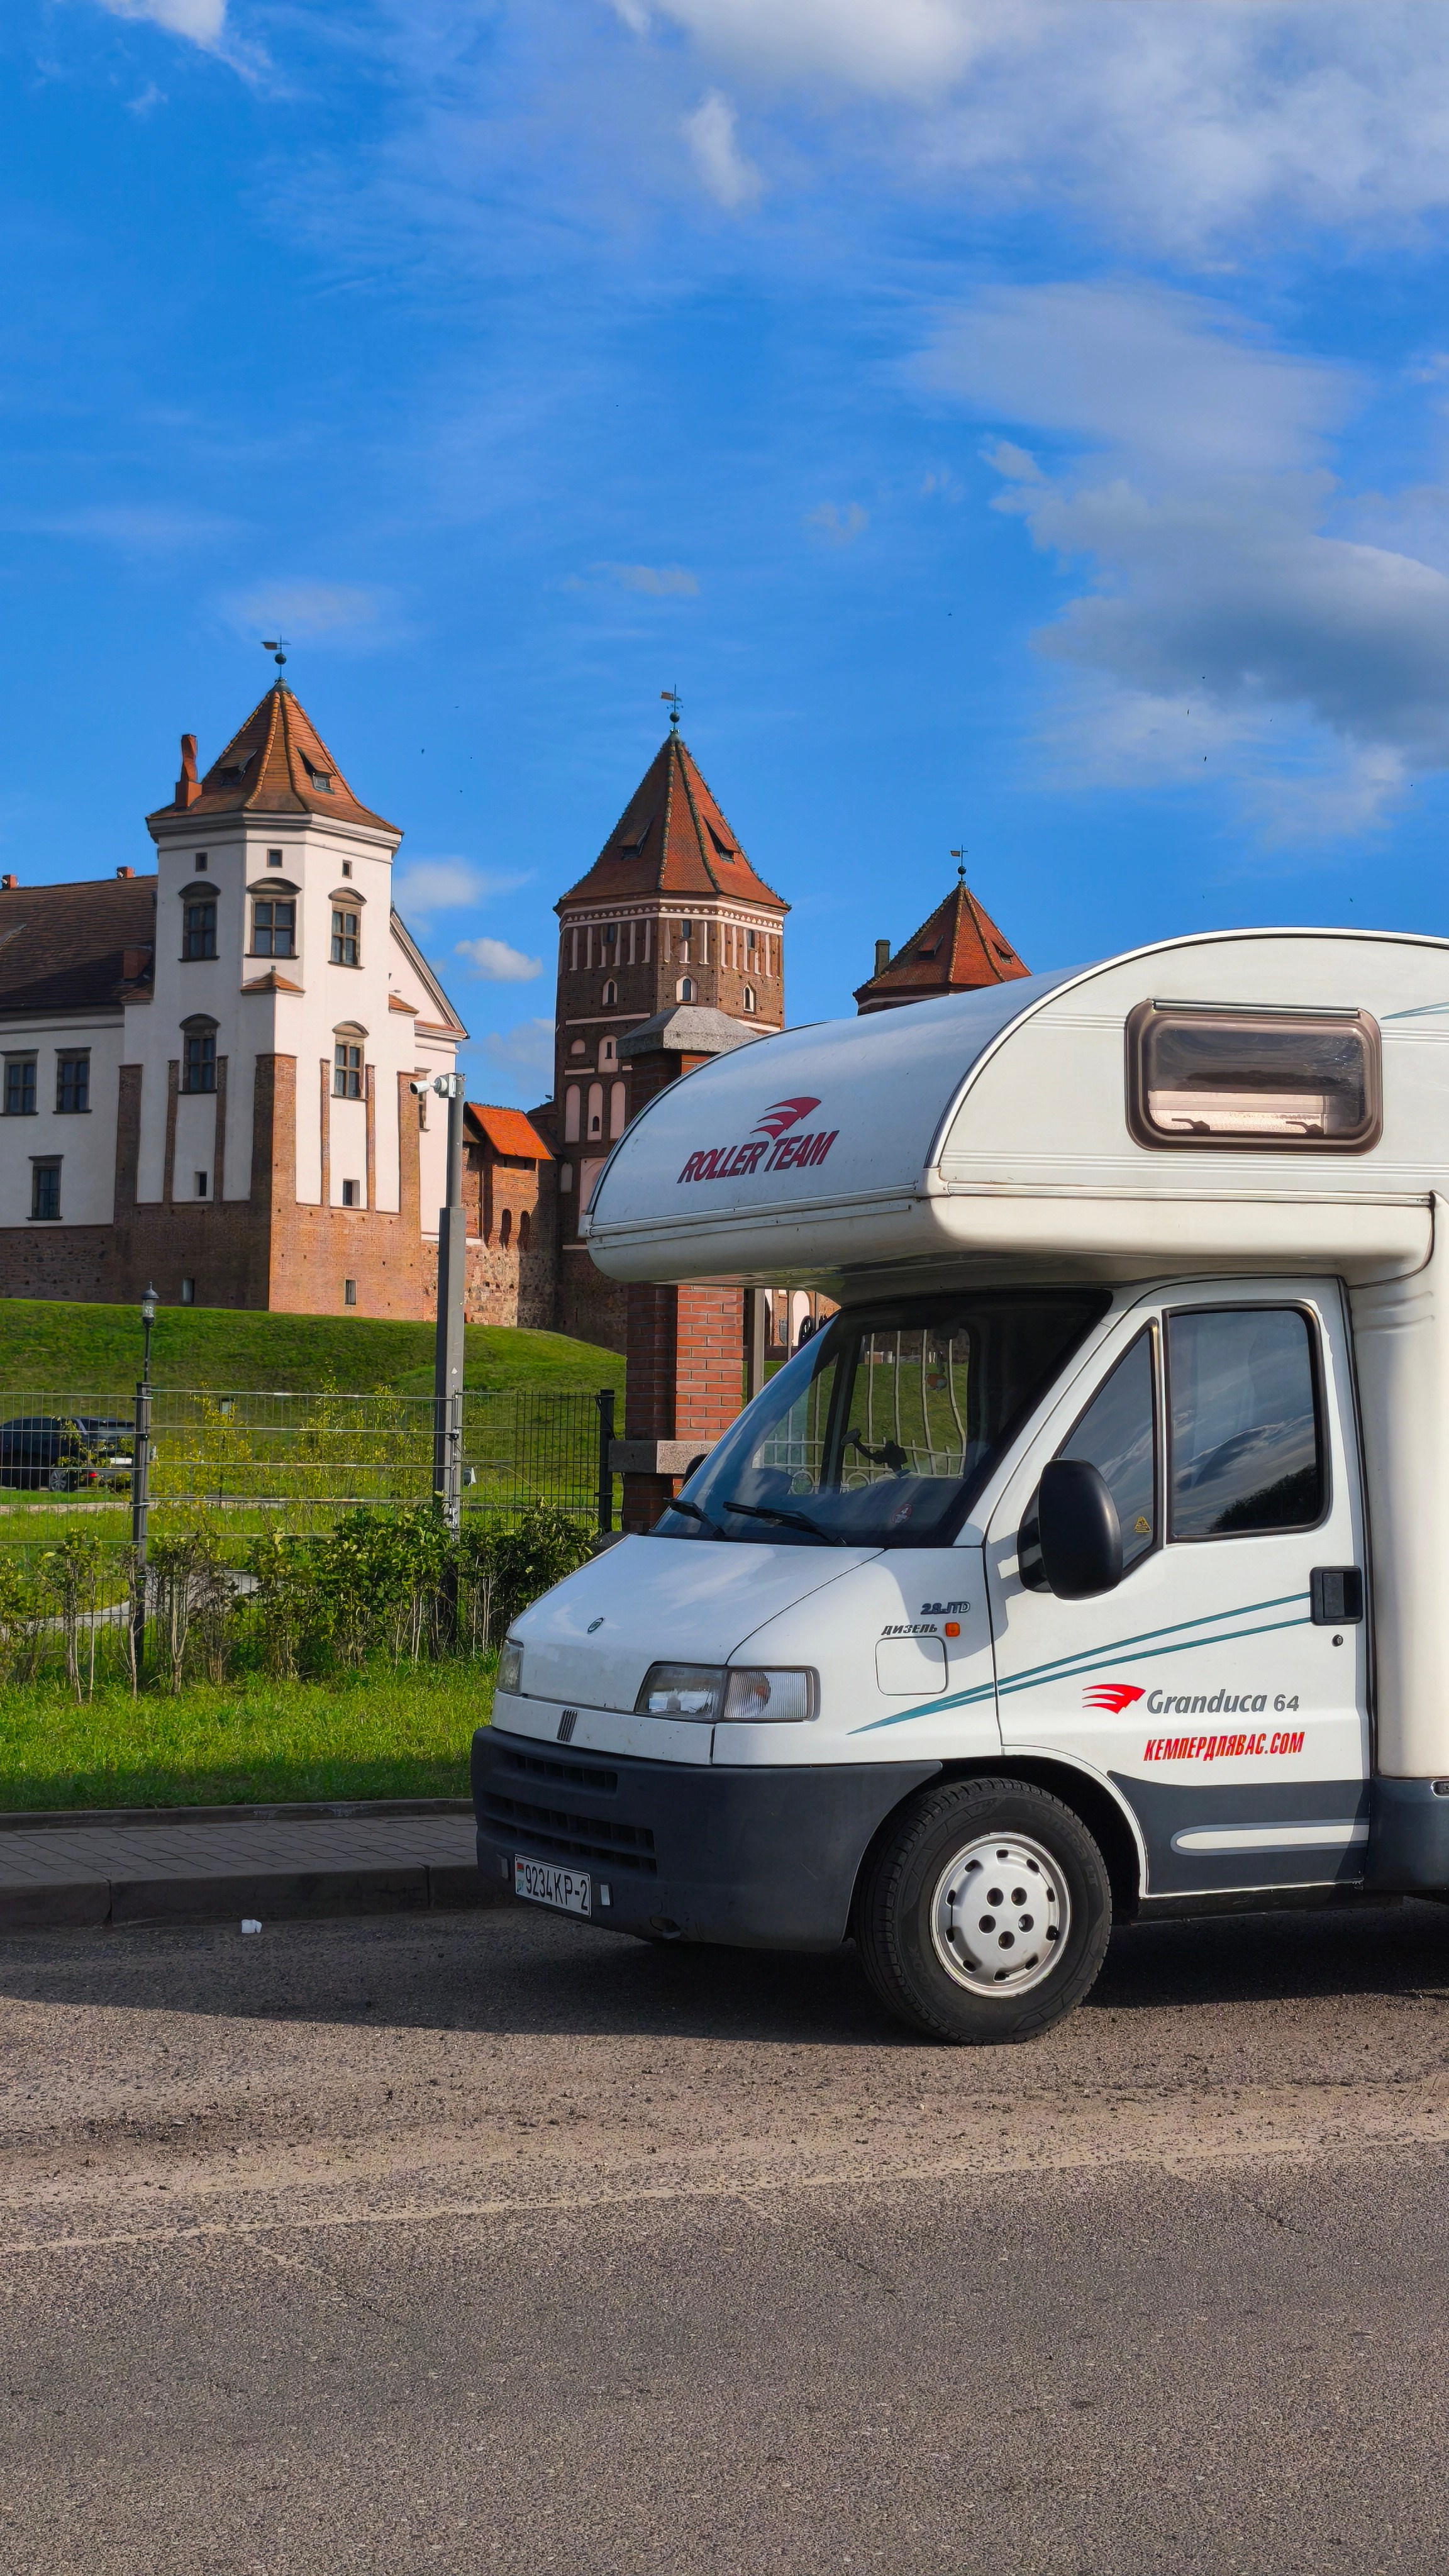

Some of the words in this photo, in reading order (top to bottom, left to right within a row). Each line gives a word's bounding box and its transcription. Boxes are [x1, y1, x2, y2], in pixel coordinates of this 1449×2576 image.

[676, 1140, 769, 1184] ROLLER
[763, 1130, 840, 1172] TEAM
[880, 1624, 938, 1636] ДИЗЕЛЬ
[1146, 1689, 1267, 1714] Granduca
[1273, 1694, 1300, 1712] 64
